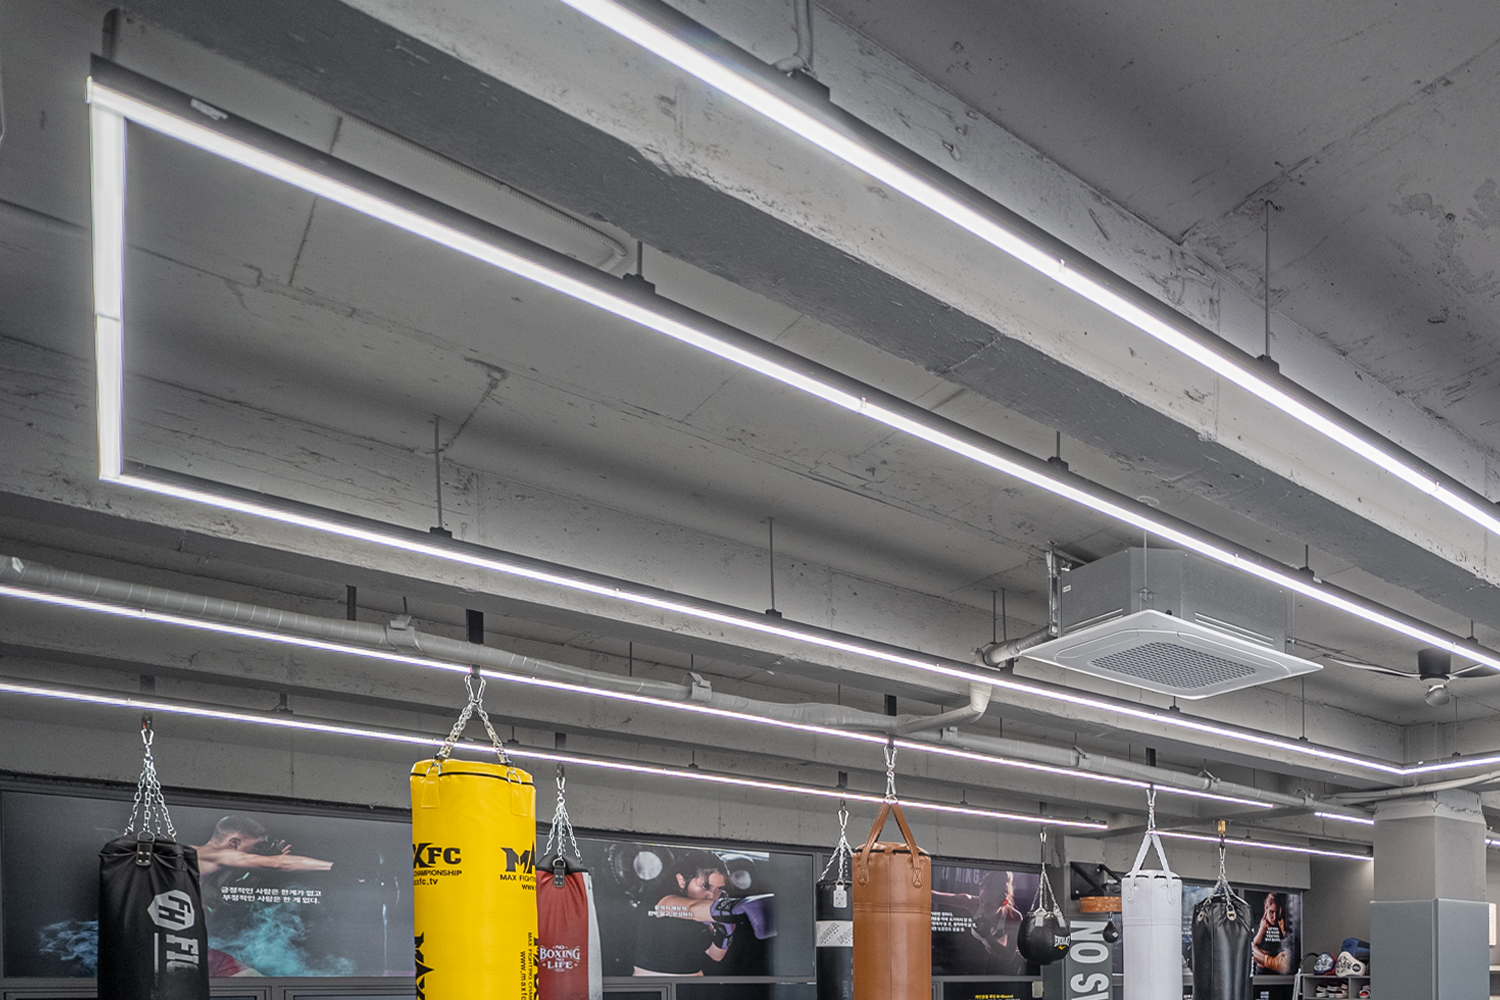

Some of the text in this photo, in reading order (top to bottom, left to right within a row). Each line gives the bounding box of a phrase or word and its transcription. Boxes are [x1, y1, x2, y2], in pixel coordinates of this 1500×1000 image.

[220, 886, 254, 895] 긍정적인
[255, 888, 279, 896] 사람은
[222, 894, 255, 902] 부정적인
[257, 895, 281, 903] 사람은
[1069, 920, 1109, 964] NO
[540, 947, 580, 960] BOXING
[547, 961, 573, 970] LIFE
